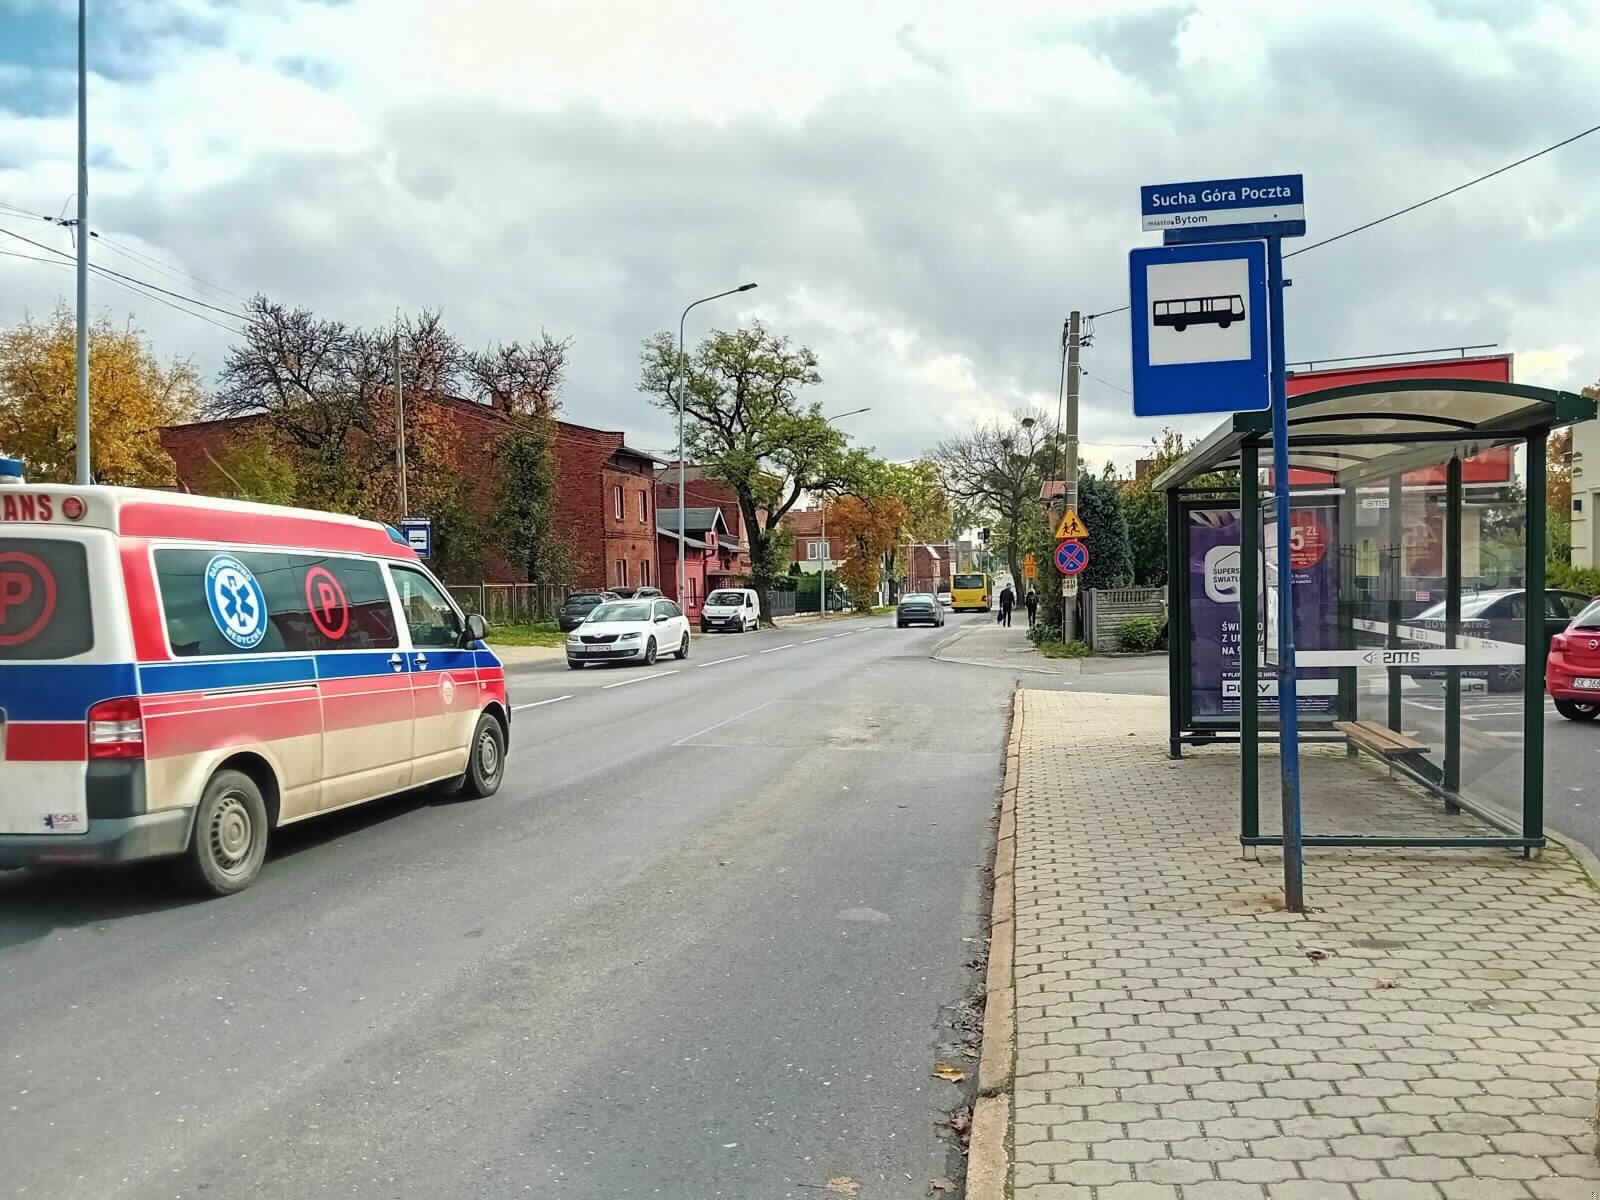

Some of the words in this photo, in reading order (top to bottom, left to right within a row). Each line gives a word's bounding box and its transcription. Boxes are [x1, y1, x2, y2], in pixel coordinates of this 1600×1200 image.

[1152, 193, 1197, 207] Sucha
[1201, 189, 1236, 203] Góra
[1241, 186, 1291, 200] Poczta
[1175, 215, 1208, 226] Bytom
[0, 494, 53, 522] ANS
[317, 582, 336, 623] P
[1222, 646, 1235, 656] NA
